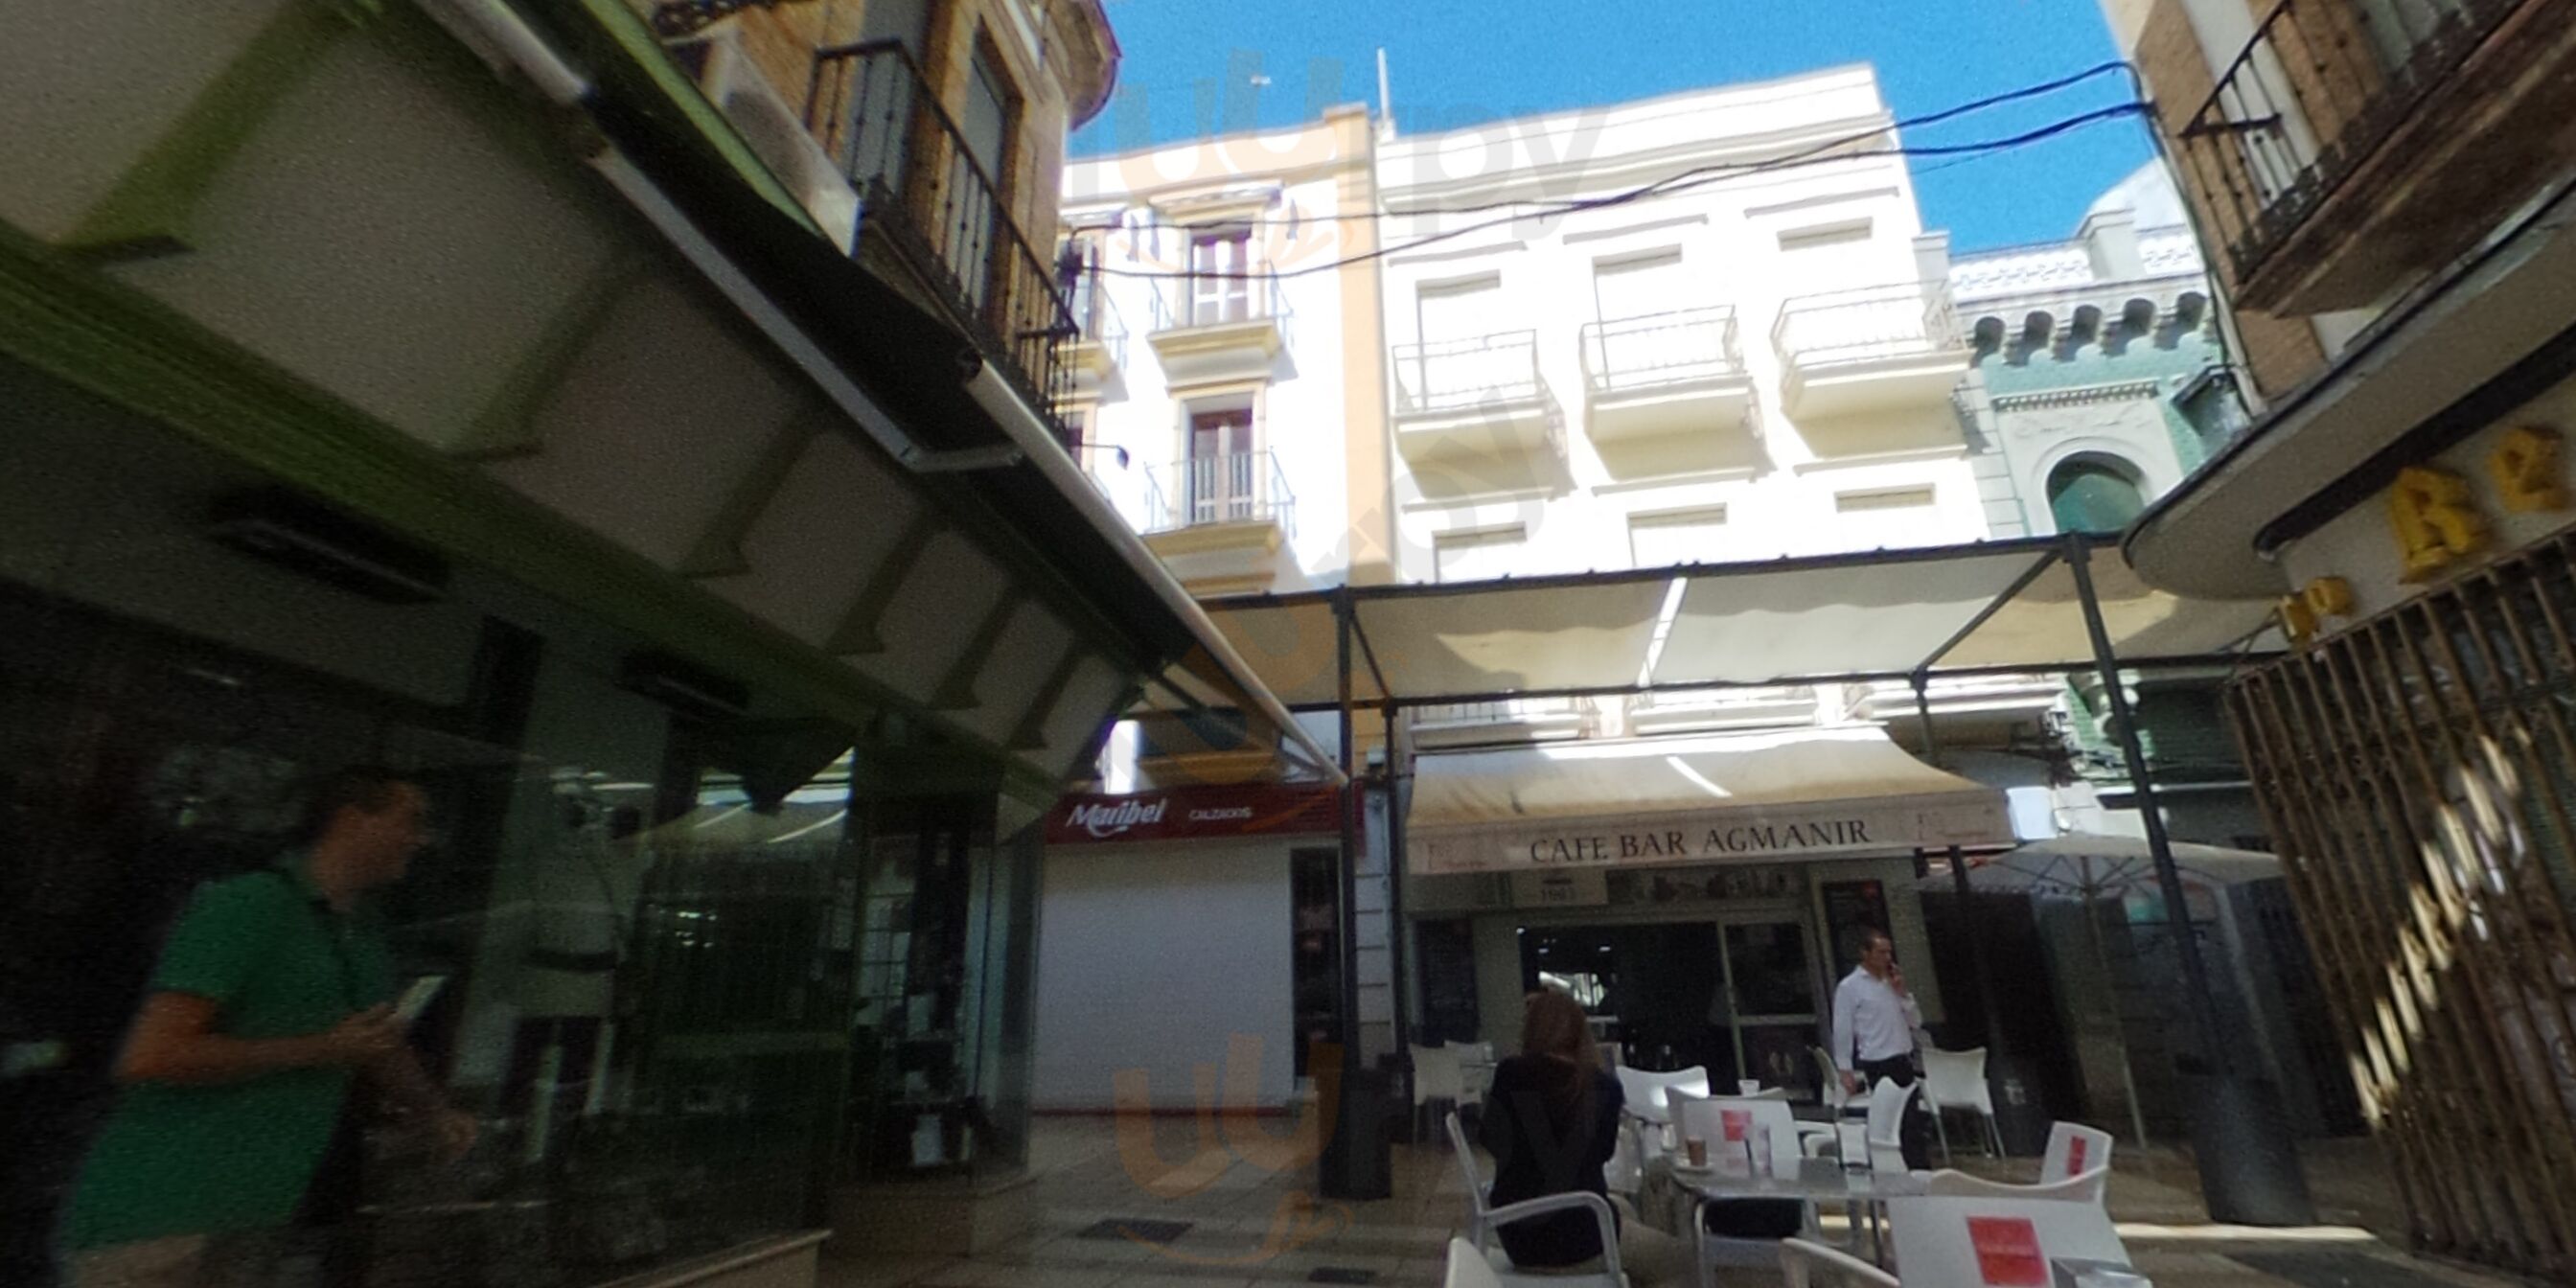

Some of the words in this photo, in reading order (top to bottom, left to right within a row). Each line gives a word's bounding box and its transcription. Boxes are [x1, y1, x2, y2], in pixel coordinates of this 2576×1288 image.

[1066, 797, 1168, 838] Maribel
[1620, 830, 1687, 860] BAR
[1704, 818, 1874, 853] AGMANIR
